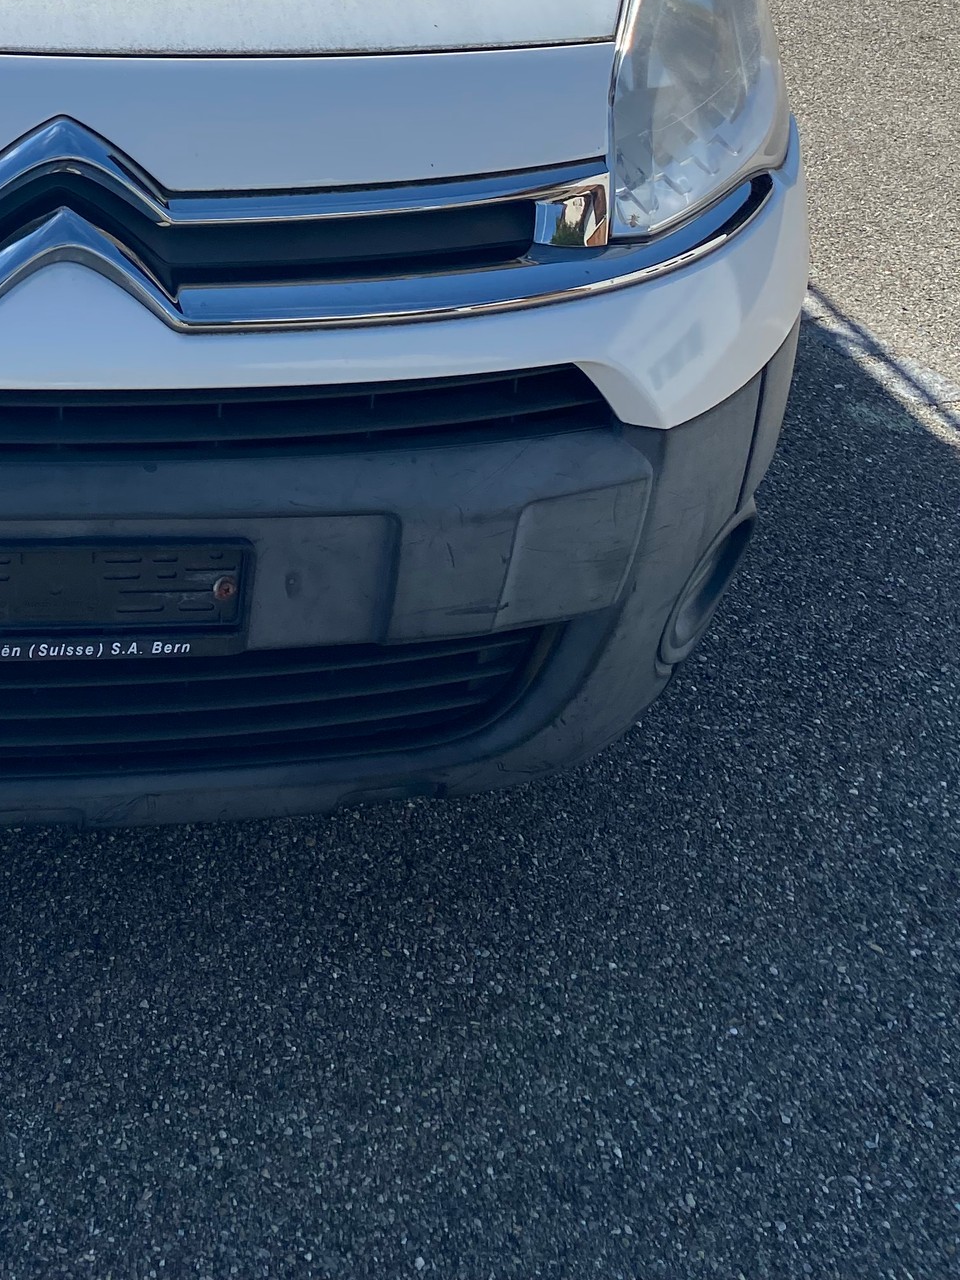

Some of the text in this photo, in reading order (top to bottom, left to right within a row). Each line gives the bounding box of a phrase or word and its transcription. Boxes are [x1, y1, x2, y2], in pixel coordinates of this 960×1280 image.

[28, 643, 103, 658] (Suisse)
[111, 642, 143, 656] S.A.
[151, 641, 191, 655] Bern
